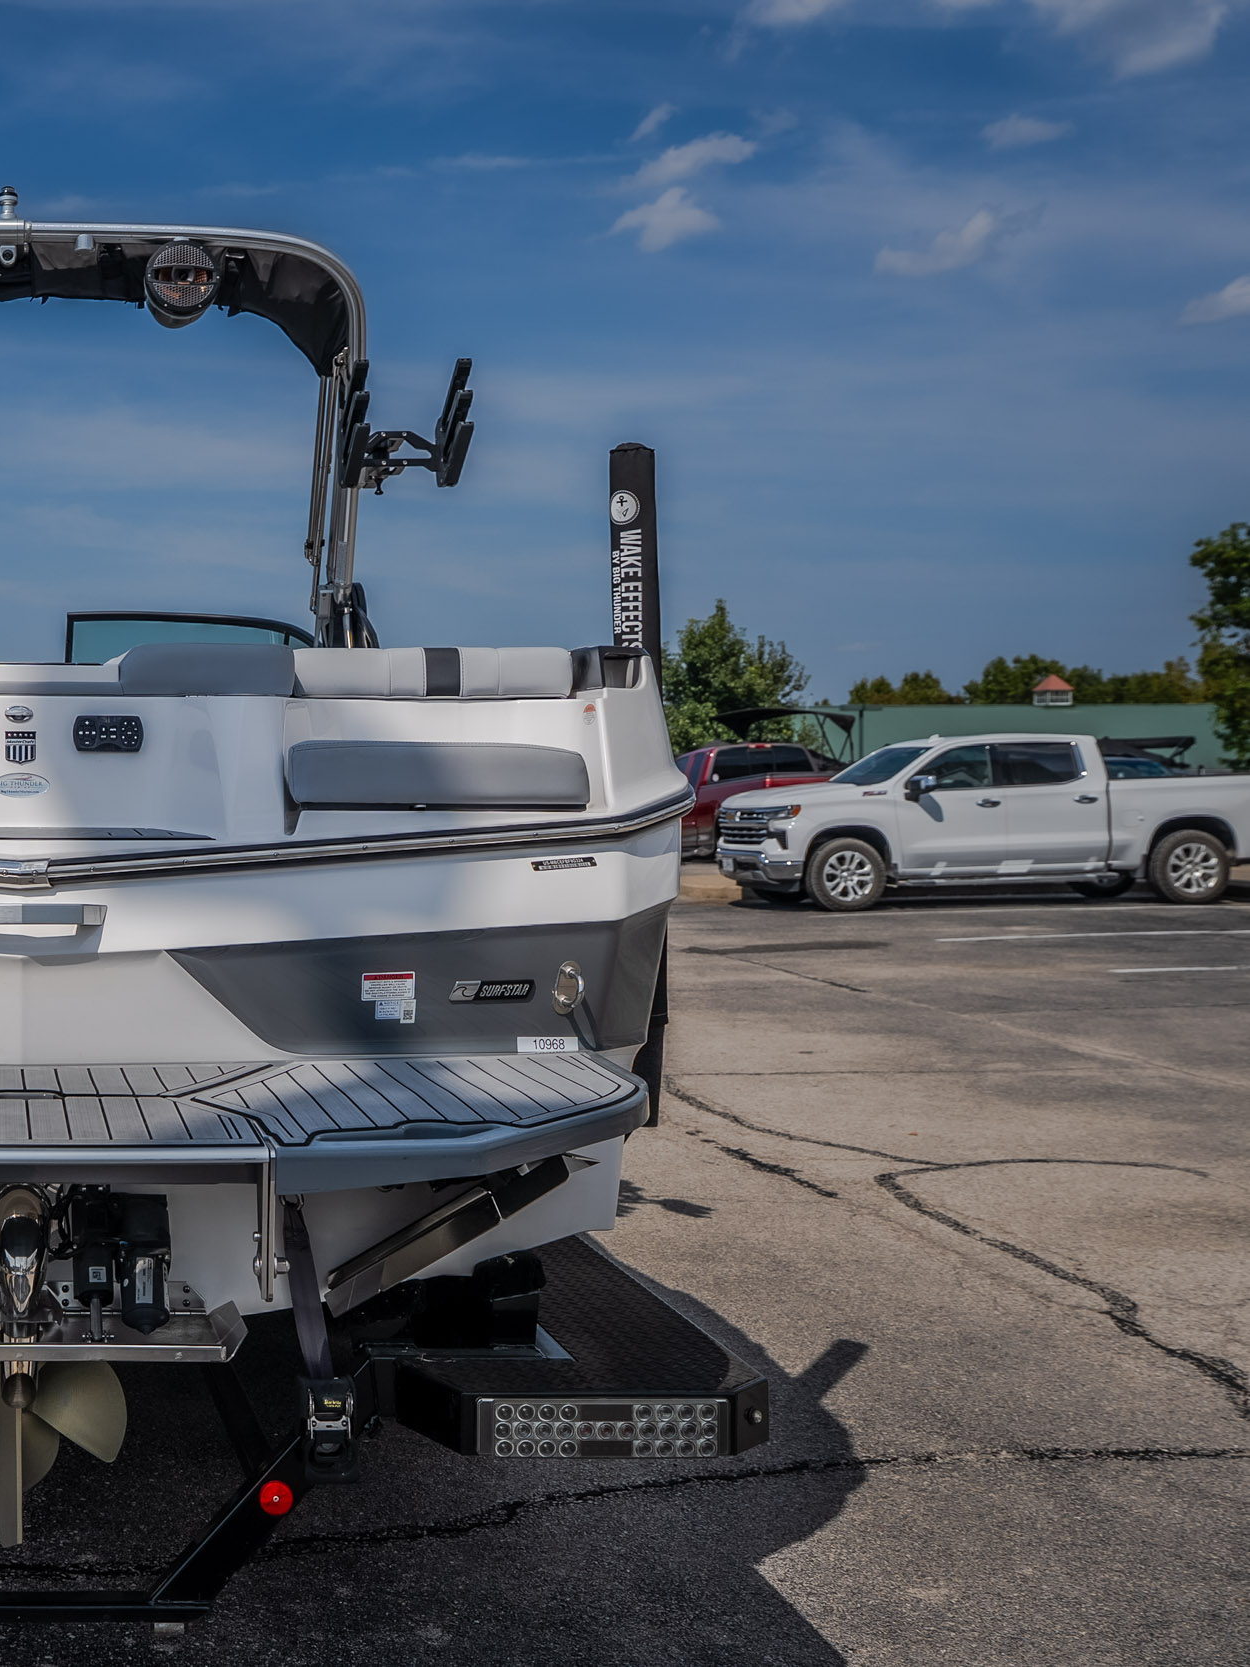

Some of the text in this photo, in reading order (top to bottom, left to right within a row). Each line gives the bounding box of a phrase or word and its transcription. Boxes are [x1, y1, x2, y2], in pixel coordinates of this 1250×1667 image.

[620, 529, 642, 578] WAKE
[612, 550, 622, 634] BY BIG THUNDER
[479, 984, 530, 997] SURFSTAR
[533, 1038, 566, 1050] 10968
